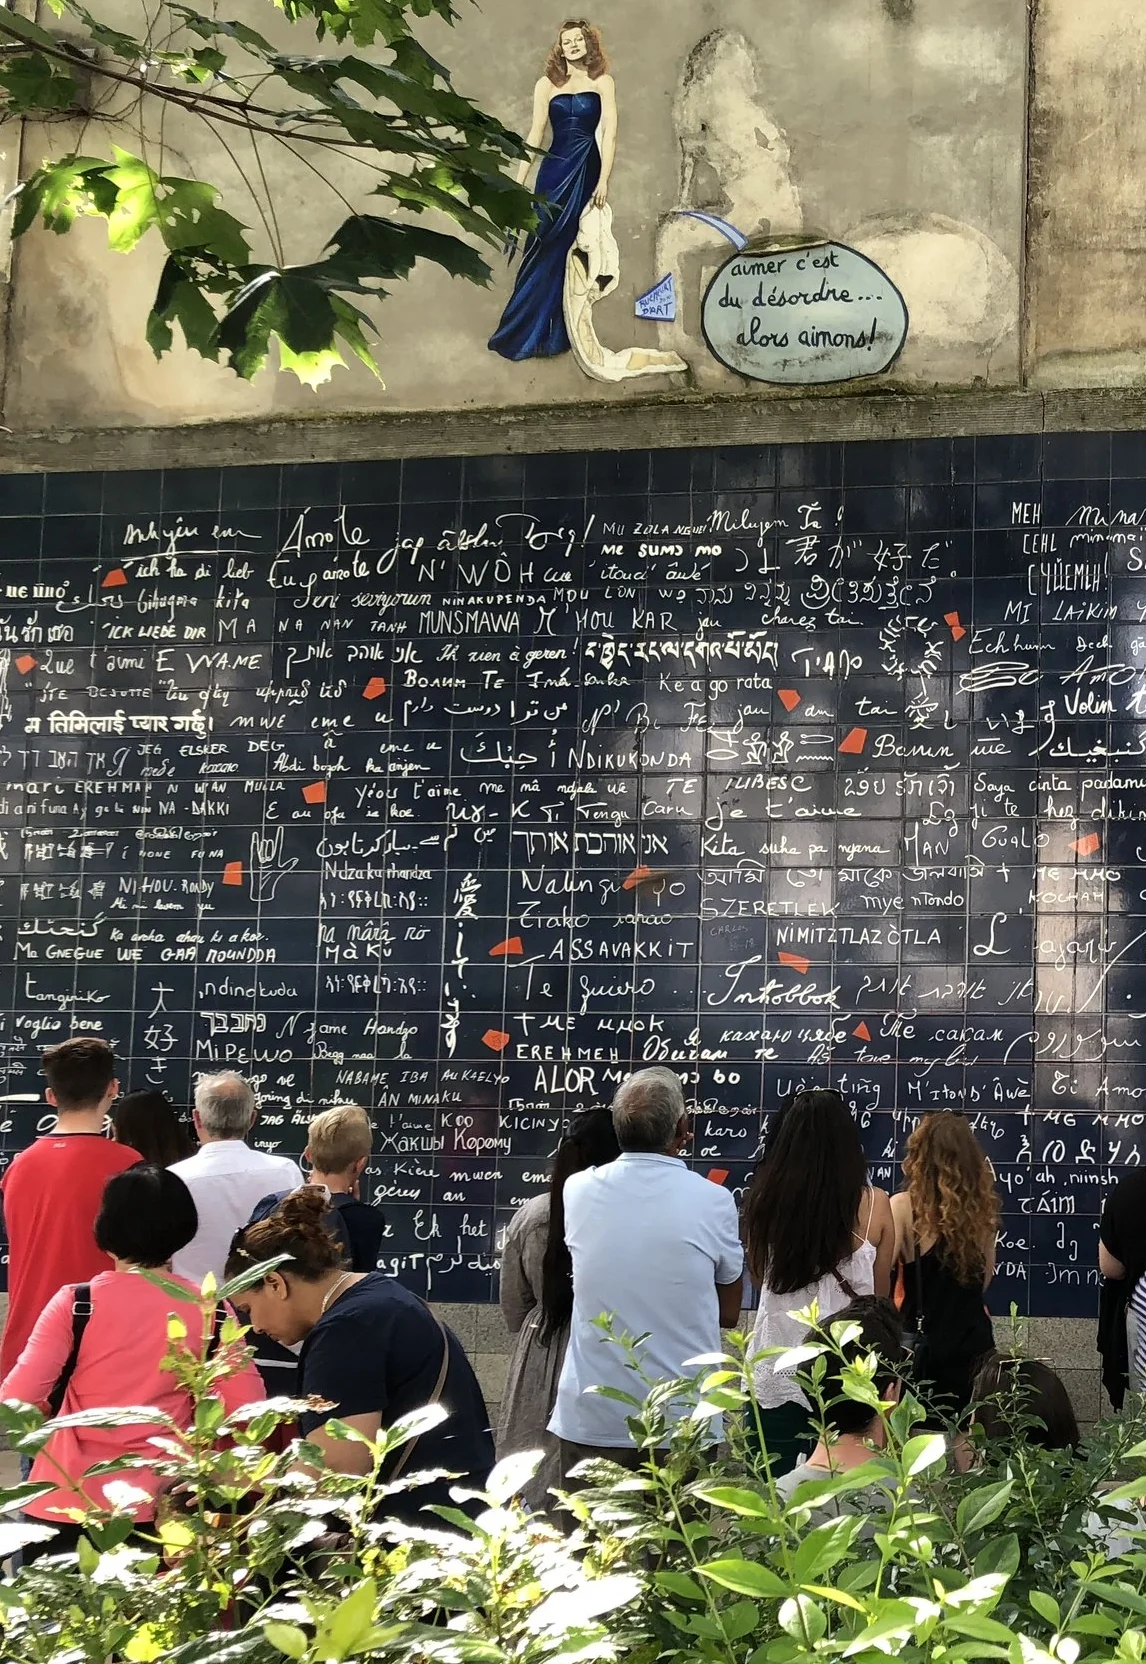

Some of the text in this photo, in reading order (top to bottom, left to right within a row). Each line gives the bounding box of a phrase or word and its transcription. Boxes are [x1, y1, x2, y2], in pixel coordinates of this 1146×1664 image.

[730, 249, 839, 278] aimer c'est
[719, 283, 743, 309] du
[737, 316, 876, 352] alors aimons!
[736, 675, 773, 692] rata
[1028, 772, 1072, 791] cinta
